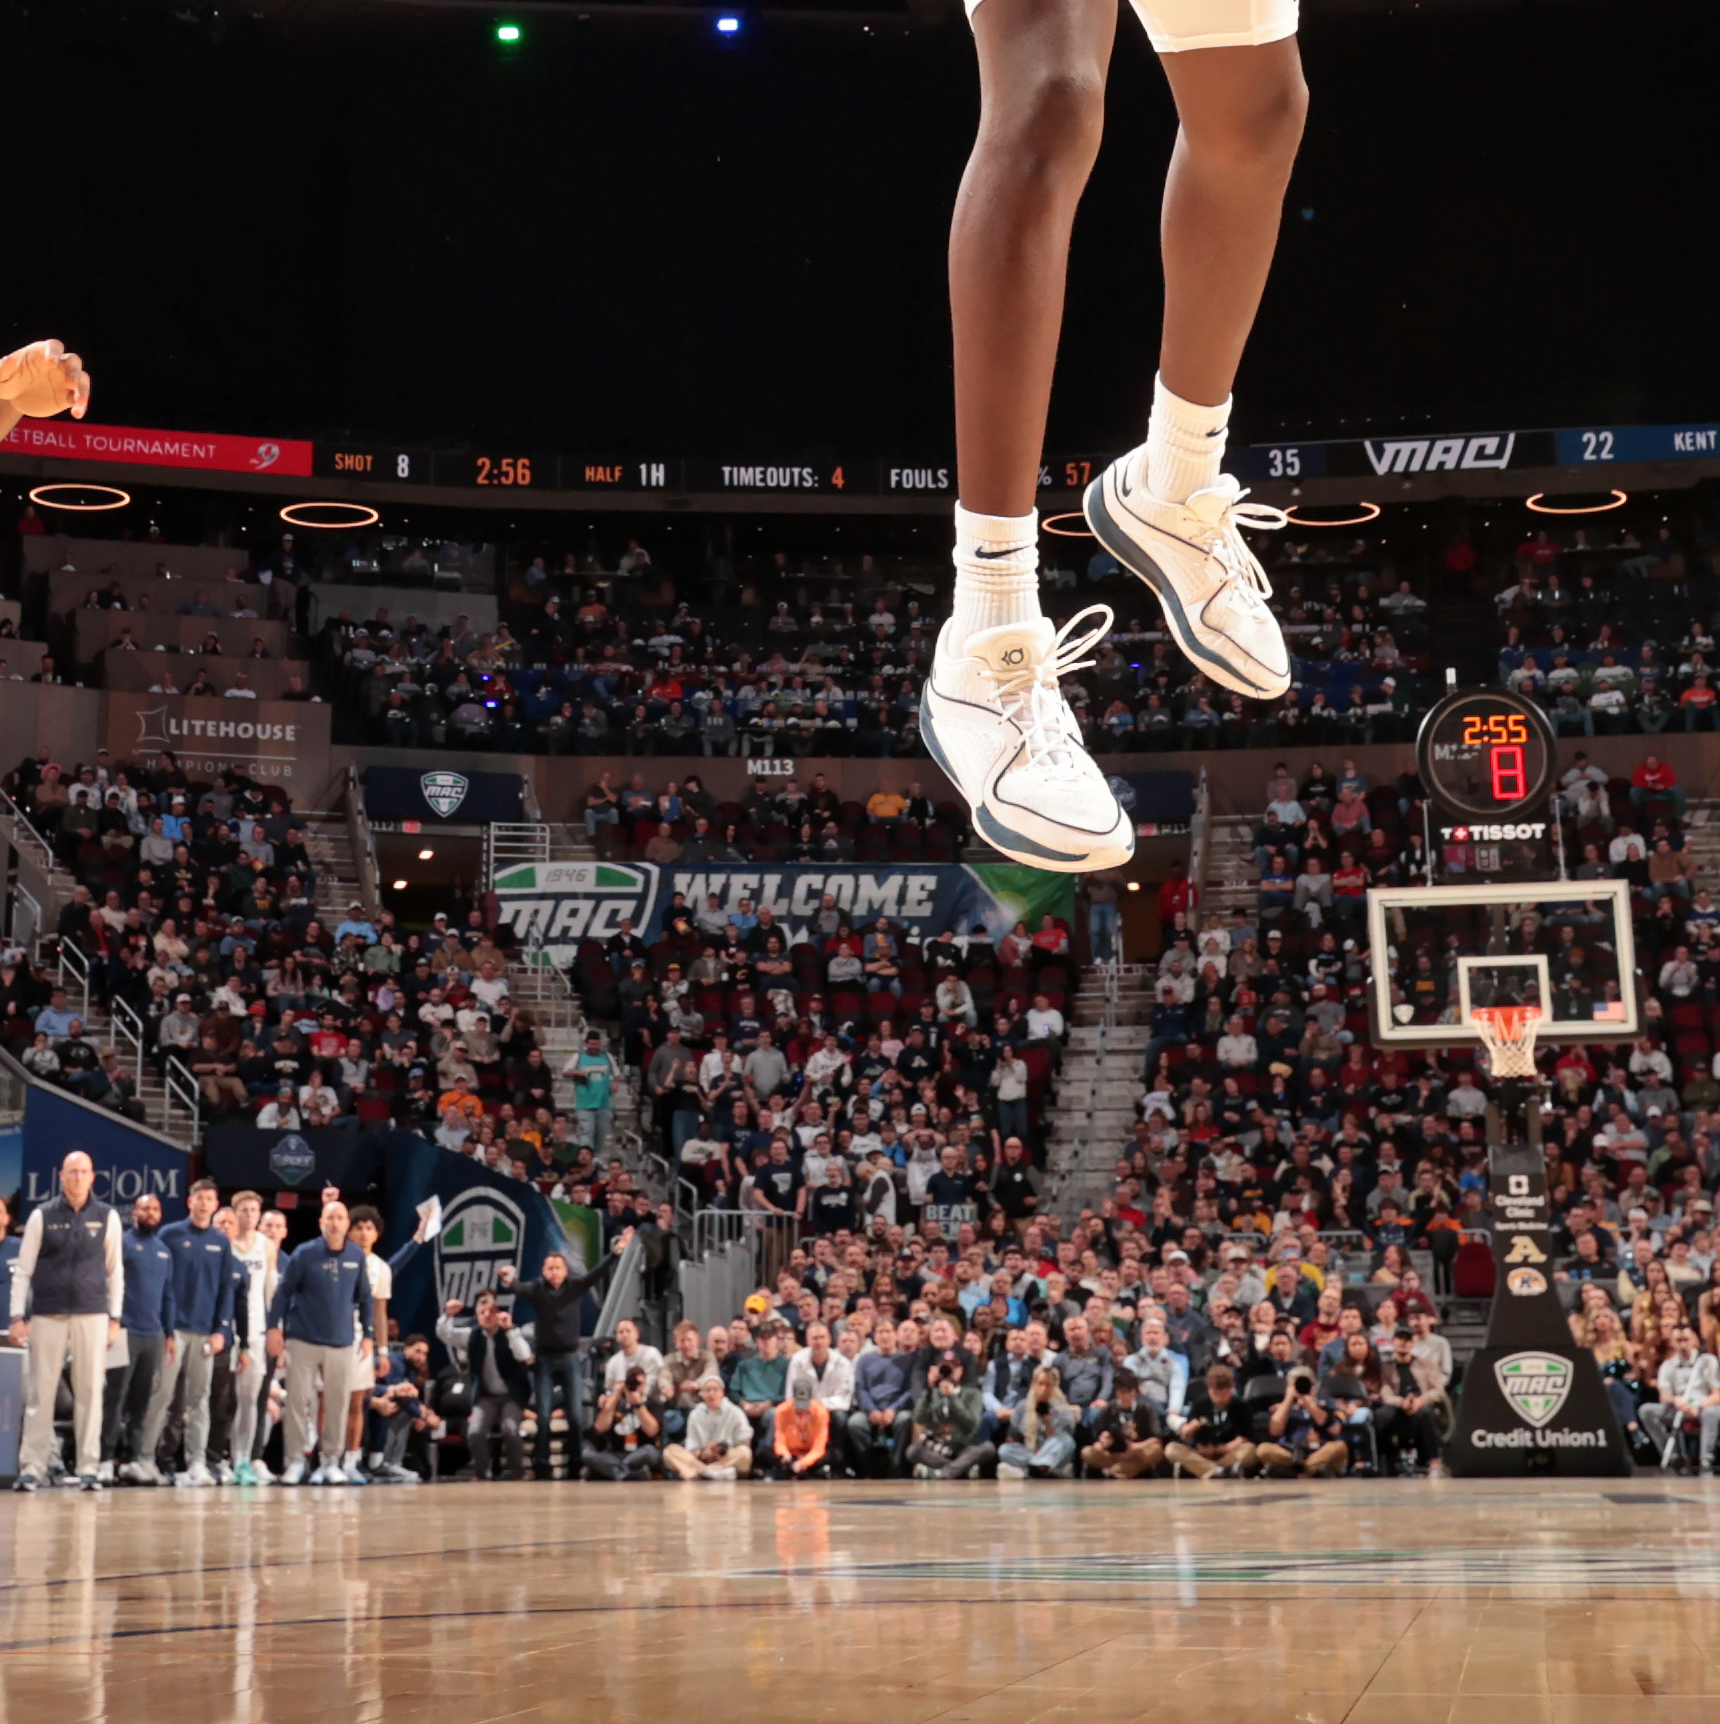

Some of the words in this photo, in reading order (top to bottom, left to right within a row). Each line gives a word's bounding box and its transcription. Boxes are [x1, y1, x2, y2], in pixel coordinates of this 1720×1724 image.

[82, 431, 217, 461] TOURNAMENT
[1370, 433, 1514, 475] MAC
[1581, 430, 1616, 463] 22
[1672, 429, 1718, 453] KENT
[333, 451, 375, 474] SHOT
[396, 453, 411, 480] 8
[475, 456, 532, 487] 2:56
[584, 464, 624, 484] HALF
[638, 462, 666, 489] 1H
[1268, 447, 1302, 478] 35
[721, 464, 820, 490] TIMEOUTS:
[830, 466, 846, 490] 4
[889, 468, 950, 491] FOULS
[168, 717, 299, 743] LITEHOUSE
[1462, 714, 1529, 746] 2:55
[746, 758, 795, 777] M113
[1490, 744, 1528, 801] 8
[422, 784, 467, 798] MAC
[1469, 822, 1547, 841] TISSOT
[673, 872, 938, 918] WELCOME
[497, 898, 639, 940] MAC
[925, 1203, 975, 1222] BEAT
[1494, 1194, 1546, 1208] Cleveland
[1504, 1205, 1536, 1220] Clinic
[1503, 1234, 1549, 1264] A
[1502, 1376, 1569, 1396] MAC
[1470, 1428, 1534, 1449] Credit
